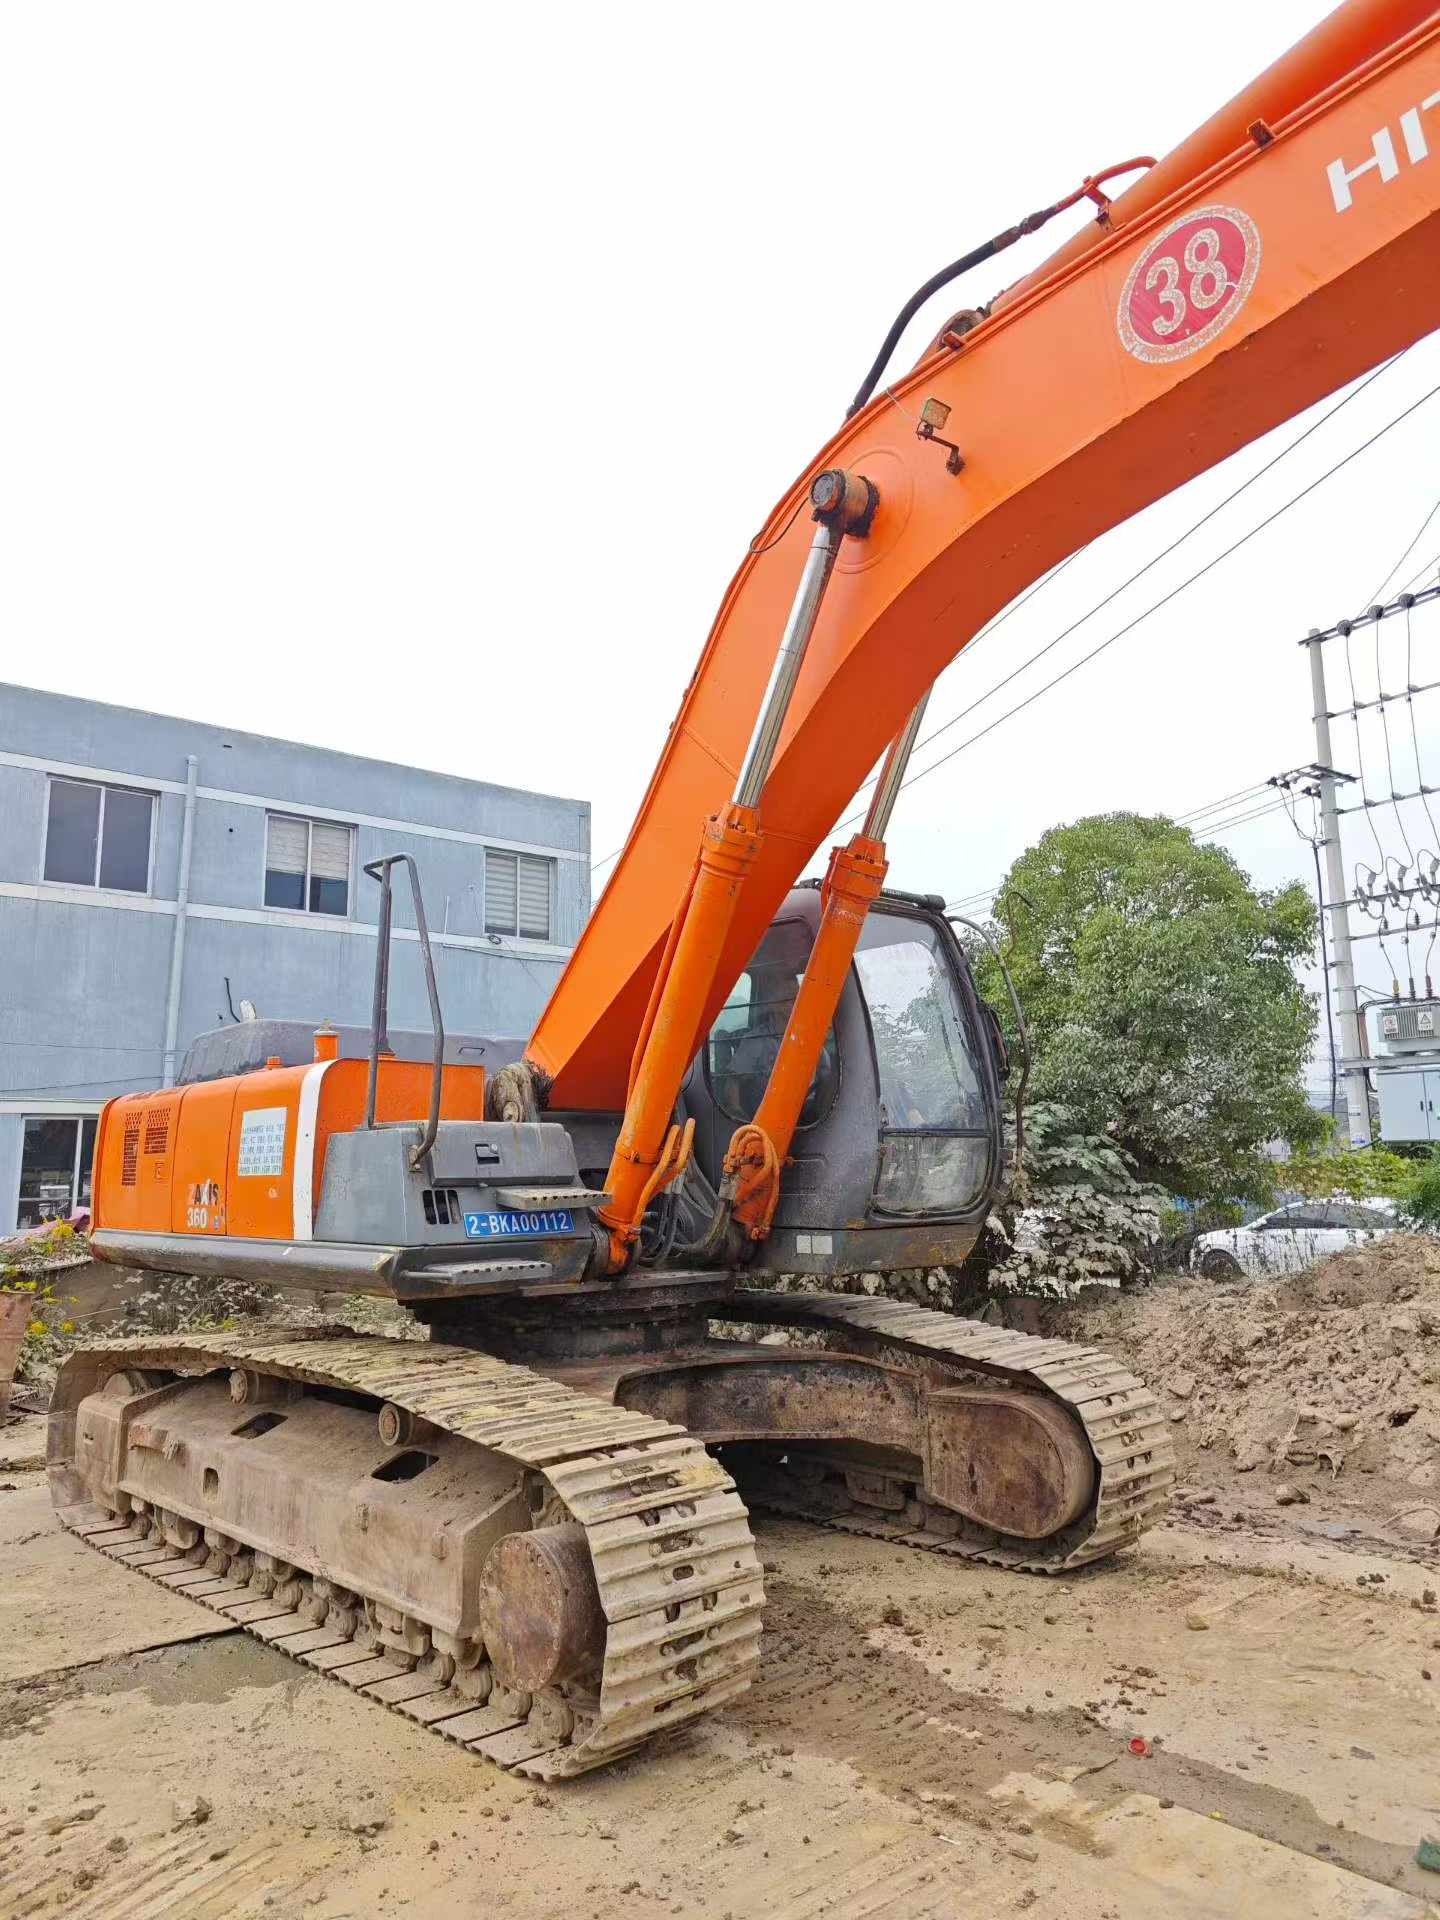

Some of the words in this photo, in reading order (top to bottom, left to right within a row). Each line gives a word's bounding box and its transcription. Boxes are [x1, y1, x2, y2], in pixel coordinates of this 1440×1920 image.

[1145, 228, 1228, 336] 38
[187, 1207, 209, 1229] 360
[468, 1212, 570, 1235] 2-BKA00112
